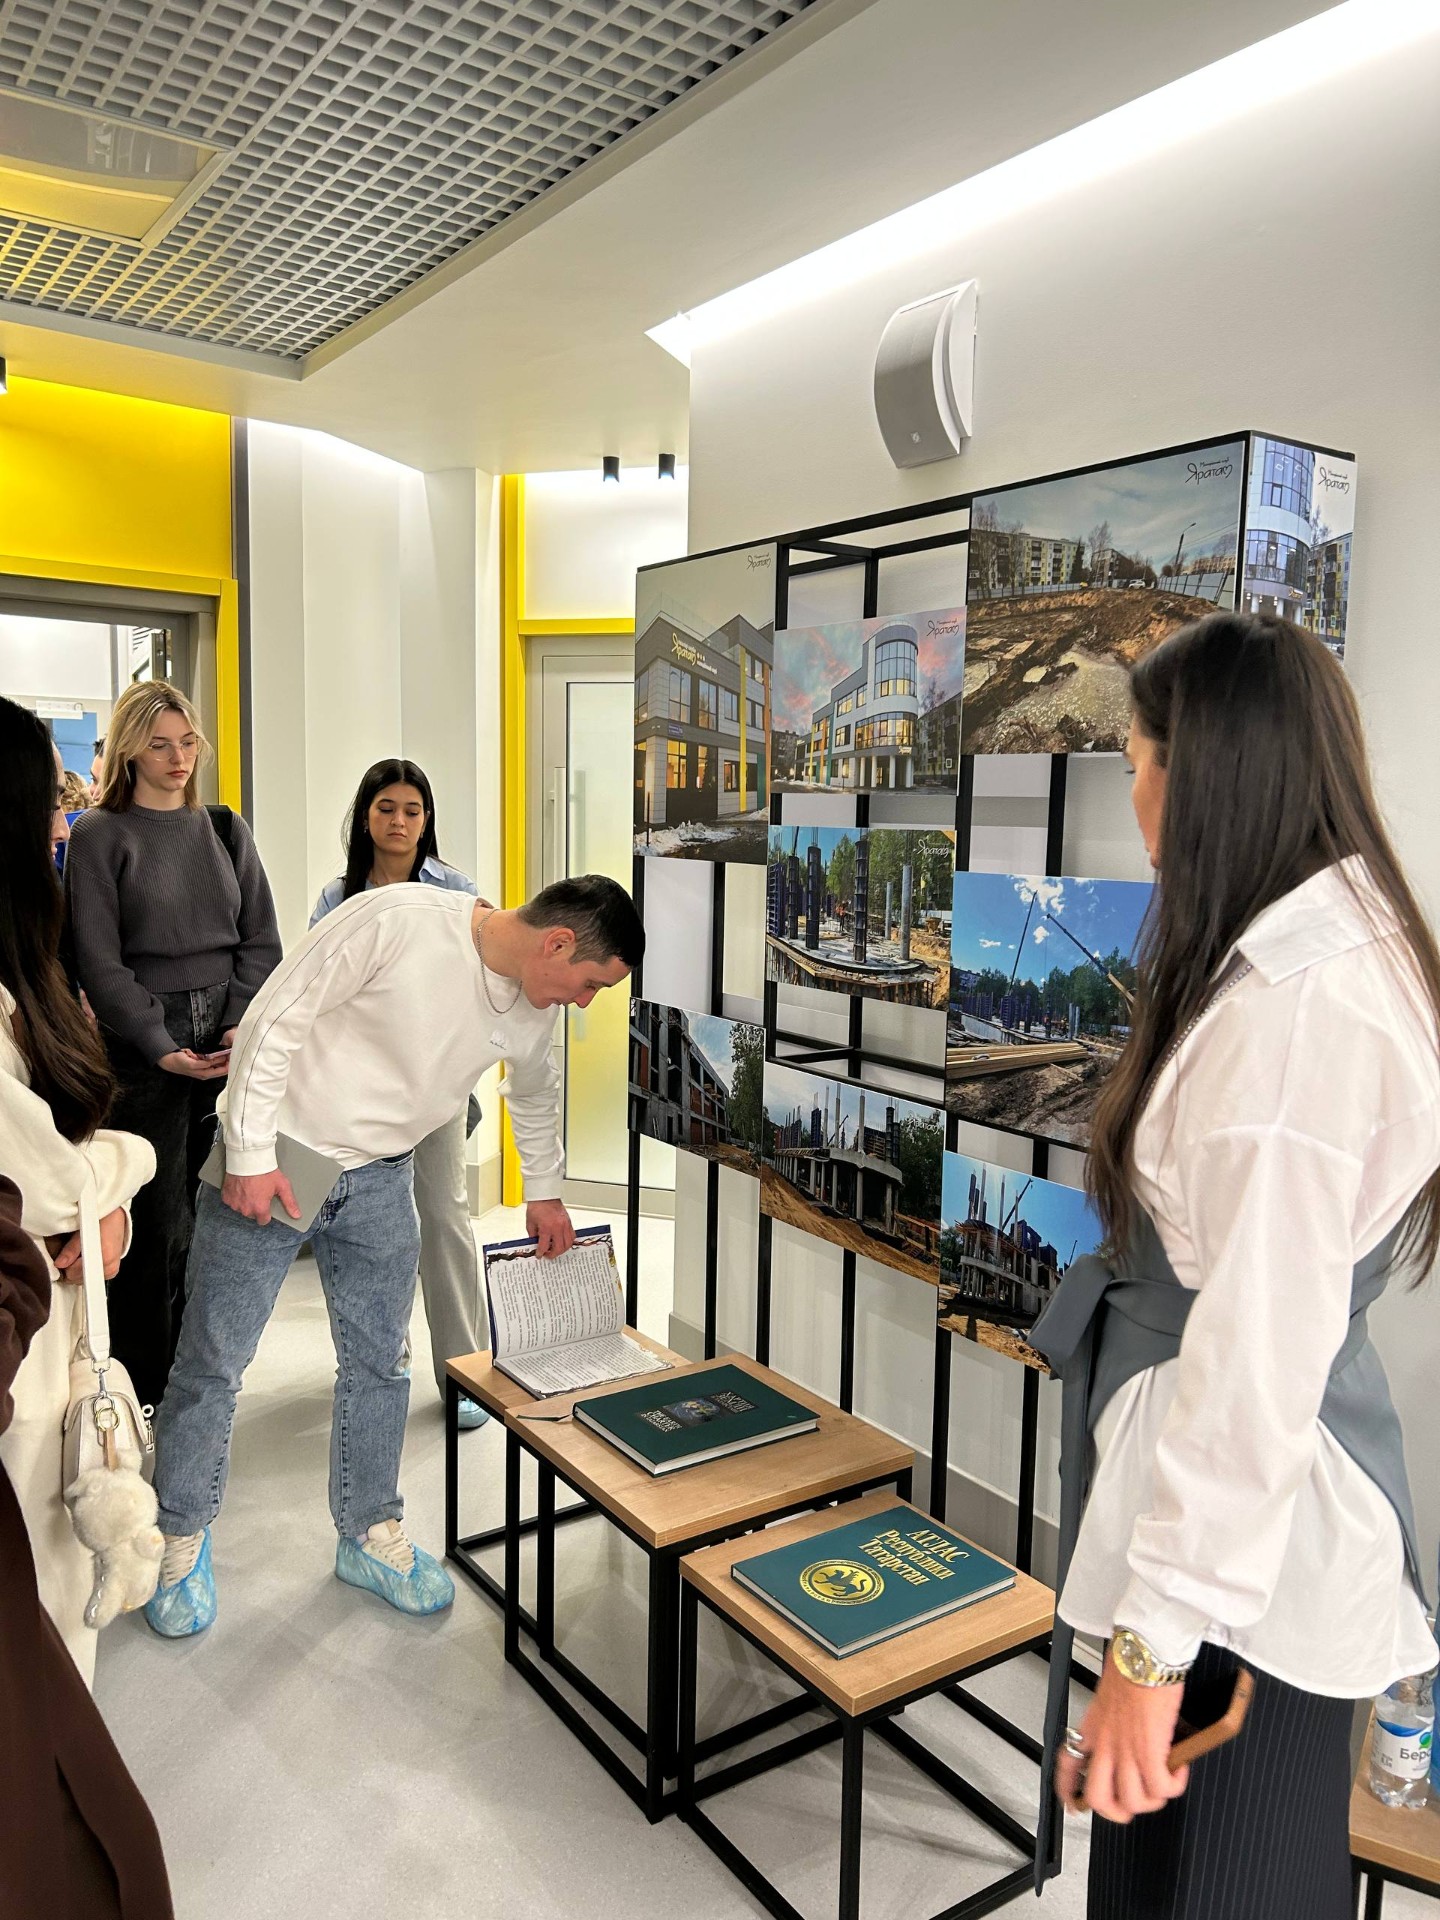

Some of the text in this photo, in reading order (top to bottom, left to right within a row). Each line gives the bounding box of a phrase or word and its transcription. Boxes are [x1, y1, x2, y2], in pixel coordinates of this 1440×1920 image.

[858, 1538, 931, 1586] Татарстан
[875, 1529, 956, 1580] Республики
[906, 1529, 971, 1563] АТЛАС
